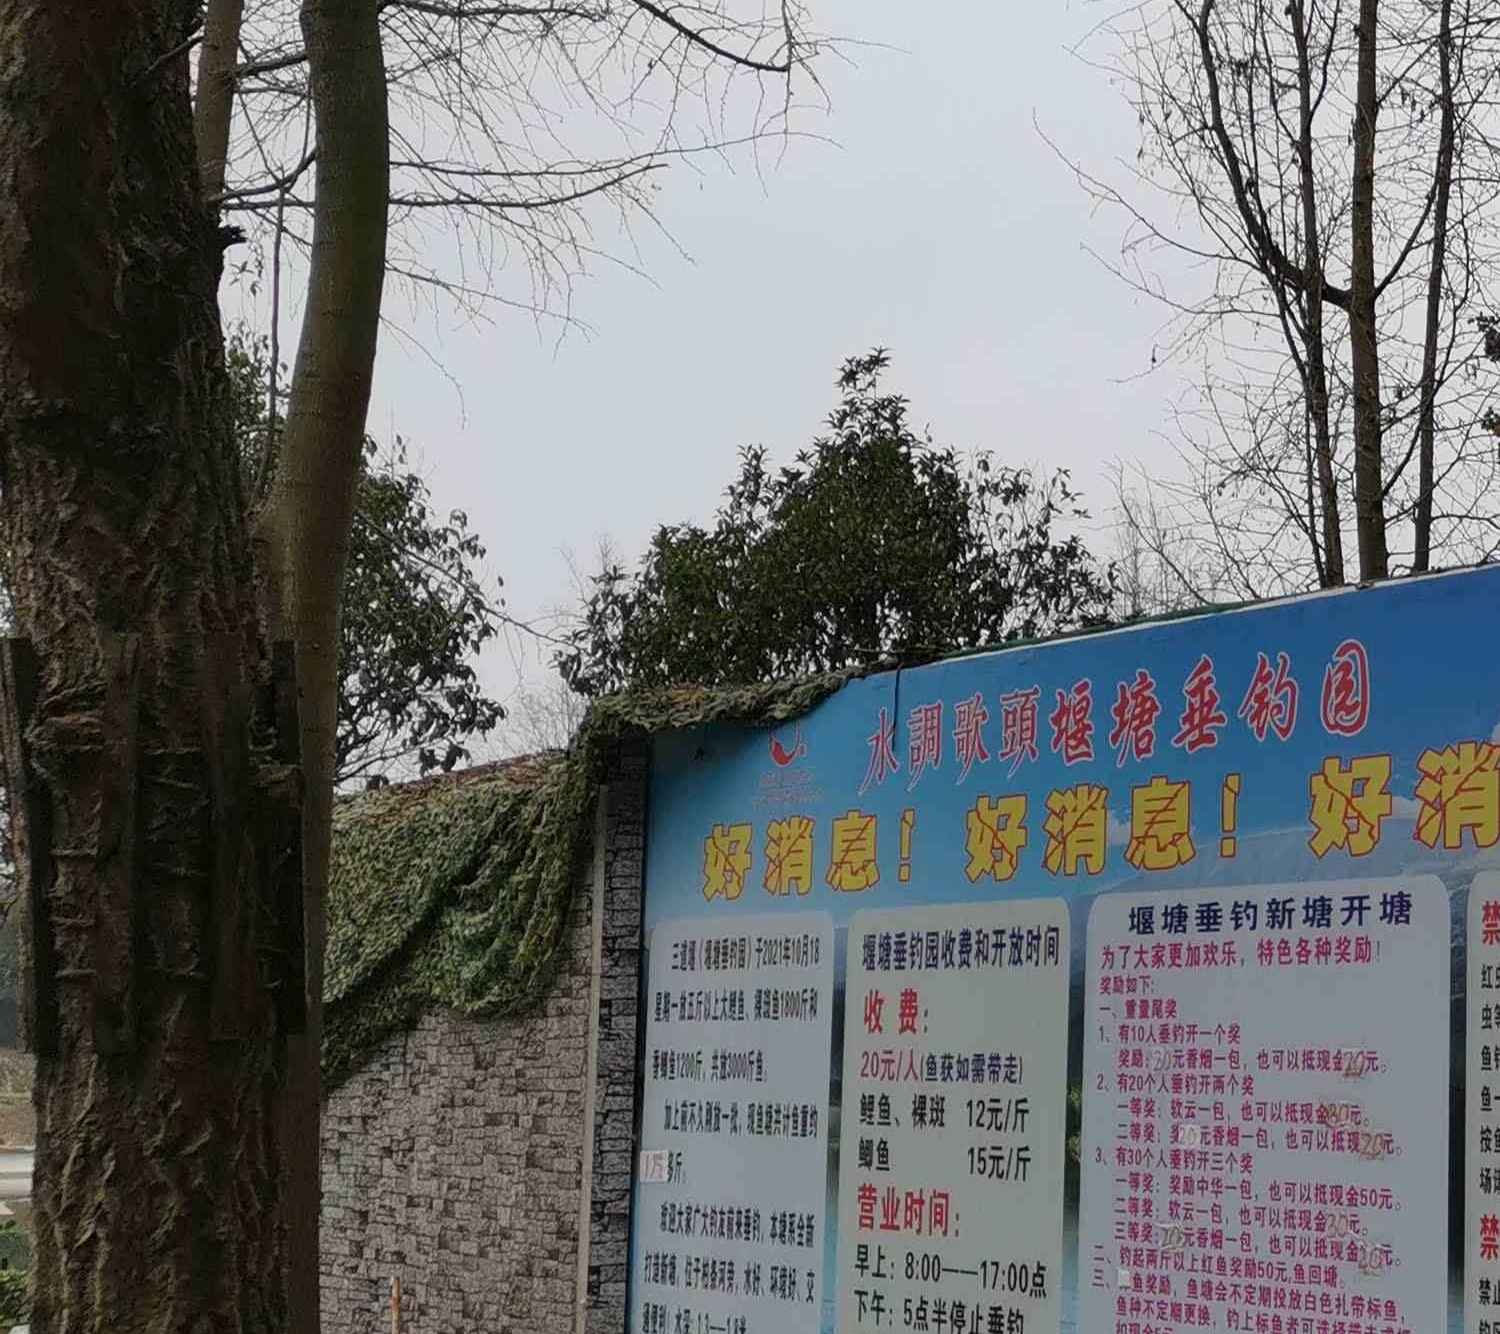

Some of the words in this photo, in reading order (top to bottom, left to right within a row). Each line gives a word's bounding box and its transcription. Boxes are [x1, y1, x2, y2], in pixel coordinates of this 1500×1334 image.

[702, 807, 915, 903] 好消息！
[963, 772, 1242, 885] 好消息！
[1127, 890, 1413, 936] 堰塘垂钓新塘开塘
[862, 924, 1061, 971] 堰塘垂钓园收费和开放时间
